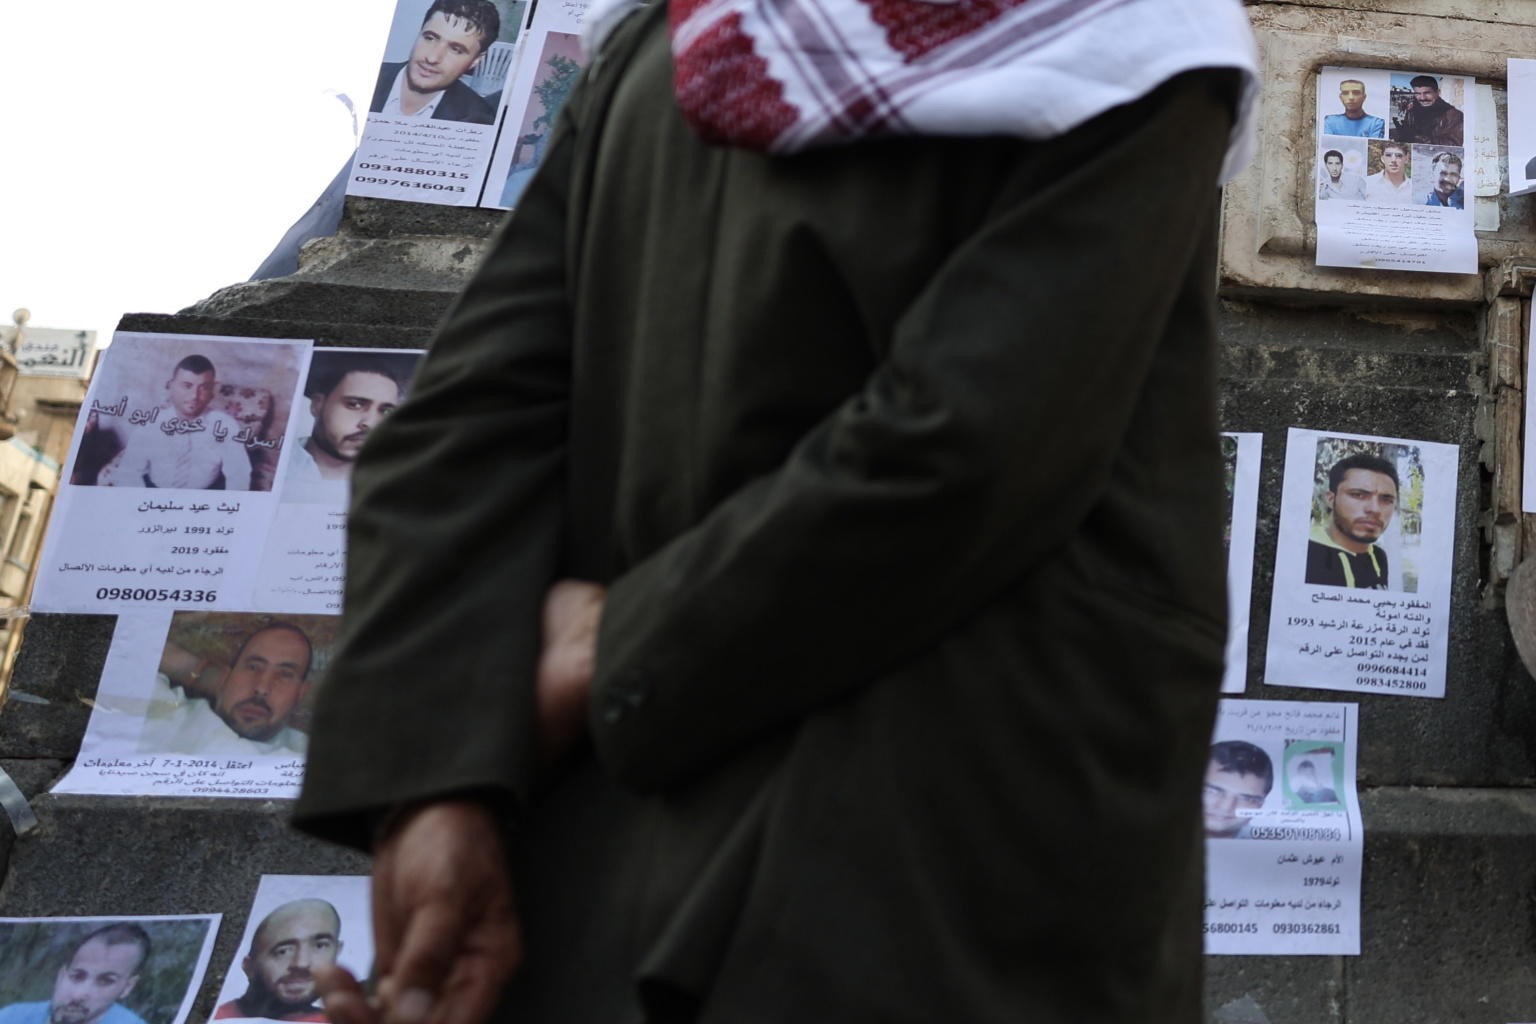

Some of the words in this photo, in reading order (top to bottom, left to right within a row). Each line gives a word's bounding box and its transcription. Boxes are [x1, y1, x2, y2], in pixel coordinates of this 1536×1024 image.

[359, 161, 470, 181] 0934880315
[355, 174, 467, 193] 0997636043
[137, 500, 184, 513] سليمان
[189, 504, 210, 513] عيد
[216, 502, 240, 515] ليث
[184, 526, 211, 535] 1991
[215, 526, 234, 536] تولد
[171, 546, 199, 554] 2019
[203, 546, 229, 555] مفقود
[96, 587, 217, 603] 0980054336
[1311, 592, 1343, 603] الصالح
[1347, 596, 1371, 604] محمد
[1400, 600, 1431, 610] المفقود
[1349, 635, 1377, 646] 2015
[1357, 663, 1427, 677] 0996684414
[1356, 677, 1426, 690] 0983452800
[1272, 923, 1340, 934] 0930362861
